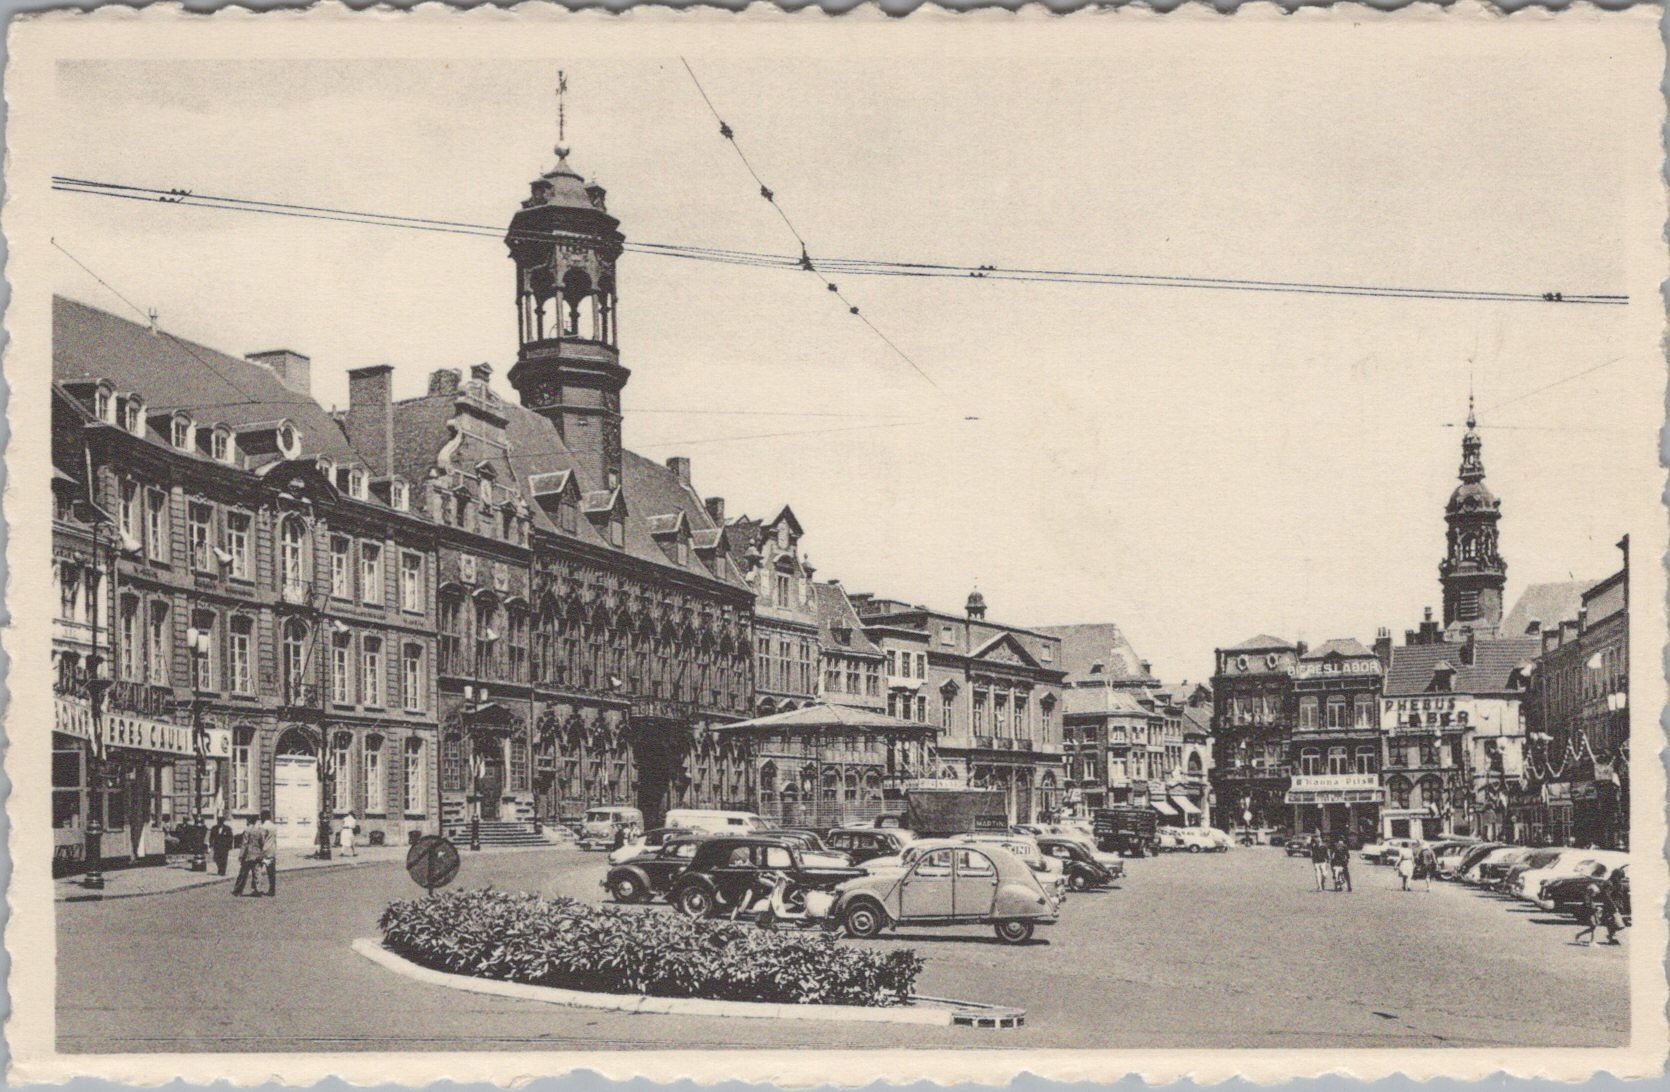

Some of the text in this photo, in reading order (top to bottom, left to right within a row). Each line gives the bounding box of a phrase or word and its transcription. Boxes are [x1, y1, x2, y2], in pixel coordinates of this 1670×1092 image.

[1334, 660, 1378, 674] LABOR
[1385, 698, 1456, 714] PHEBUS
[150, 725, 211, 753] CAULIR
